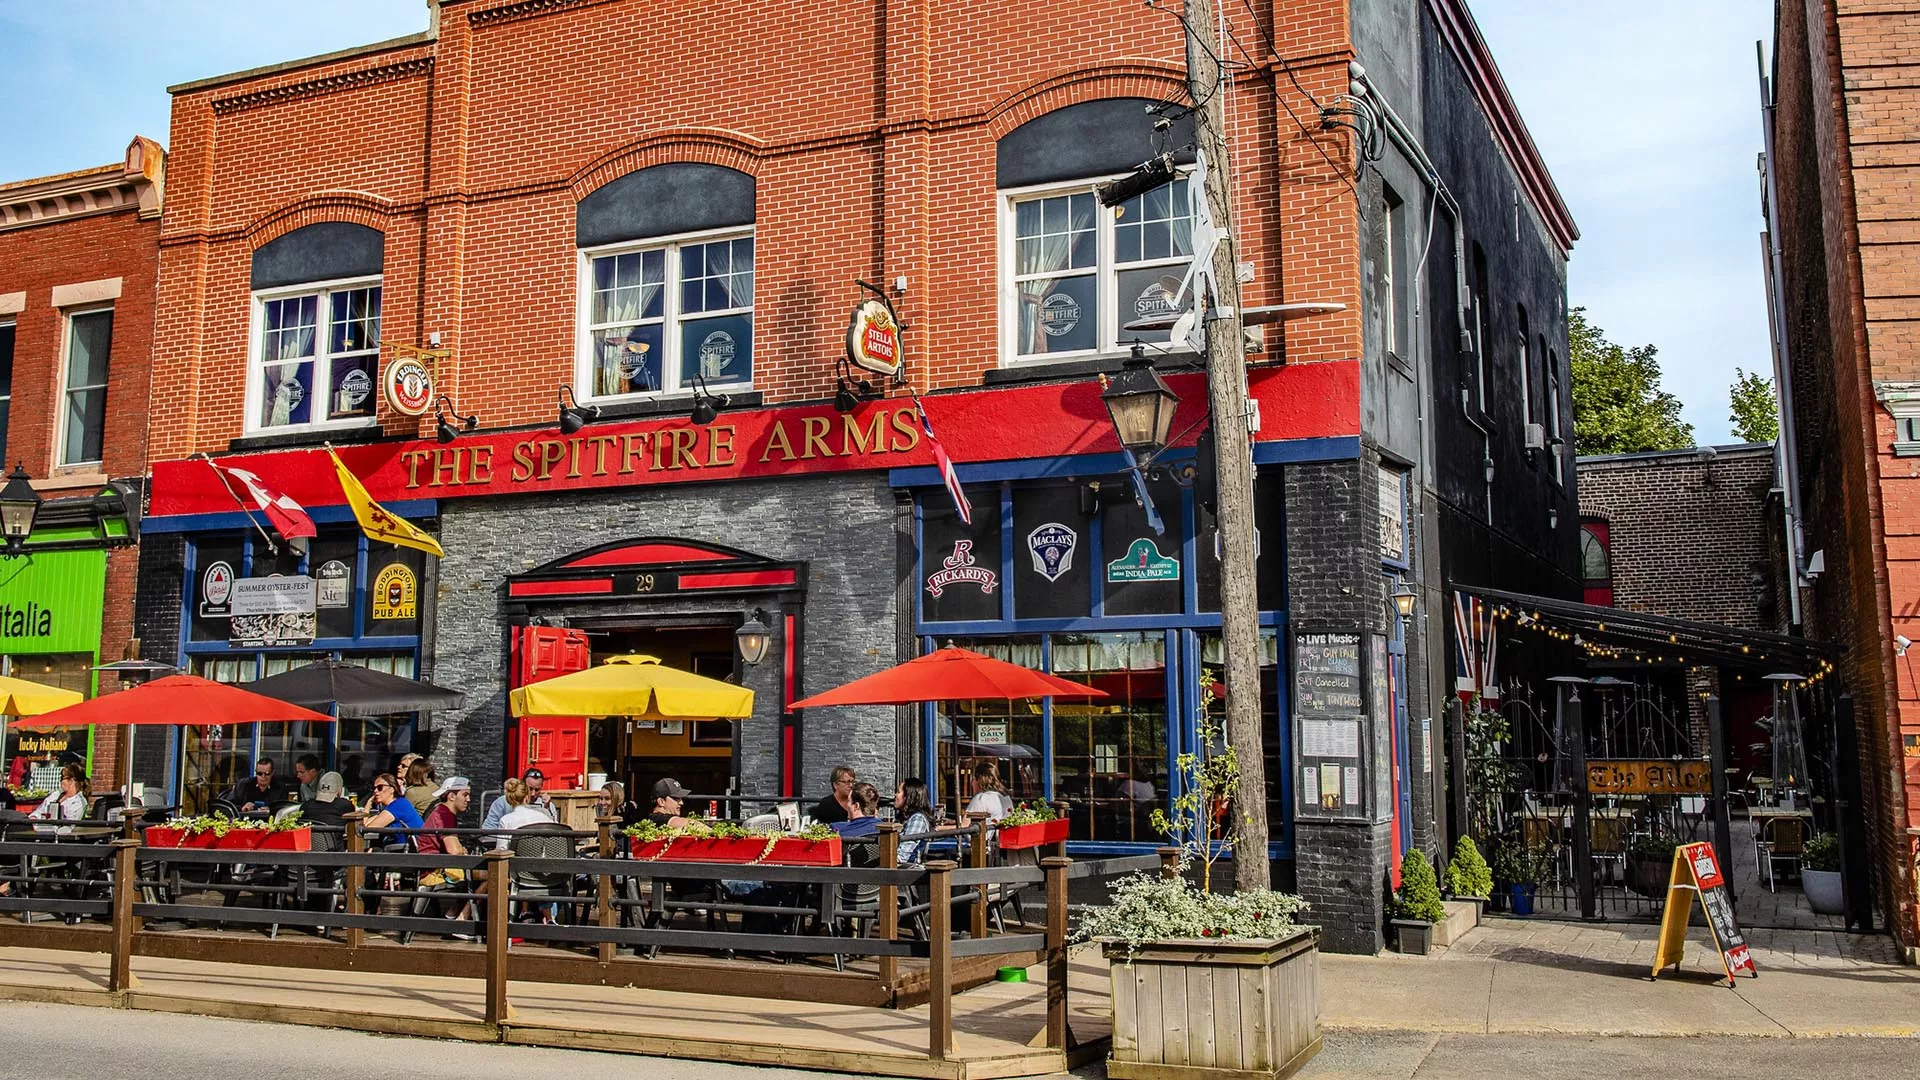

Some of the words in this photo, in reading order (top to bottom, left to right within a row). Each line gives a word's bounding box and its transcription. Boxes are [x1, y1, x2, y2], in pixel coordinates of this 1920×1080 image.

[1039, 309, 1078, 320] SPITFIRE
[868, 329, 892, 346] STELLA
[701, 345, 734, 356] SPITFIRE
[868, 341, 892, 357] ARTOIS
[397, 365, 428, 387] ERDINGER
[341, 382, 372, 392] SPITFIRE
[401, 445, 495, 488] THE
[511, 423, 737, 482] SPITFIRE
[759, 407, 920, 463] ARMS
[1032, 534, 1073, 549] MACLAYS
[933, 569, 989, 588] RICKARD'S
[1125, 570, 1146, 578] INDIA
[1146, 569, 1163, 577] PALE
[238, 585, 266, 593] SUMMER
[266, 582, 310, 591] OYSTER-FEST
[377, 568, 413, 596] BODDINGTONS
[636, 574, 654, 591] 29
[375, 609, 394, 618] PUB
[397, 608, 415, 618] ALE
[1306, 635, 1327, 644] LIVE
[1327, 633, 1353, 644] Music
[1298, 676, 1312, 685] SAT
[1300, 692, 1313, 700] SUN
[19, 736, 39, 753] lucky
[39, 736, 68, 751] italiano
[1589, 765, 1636, 792] The
